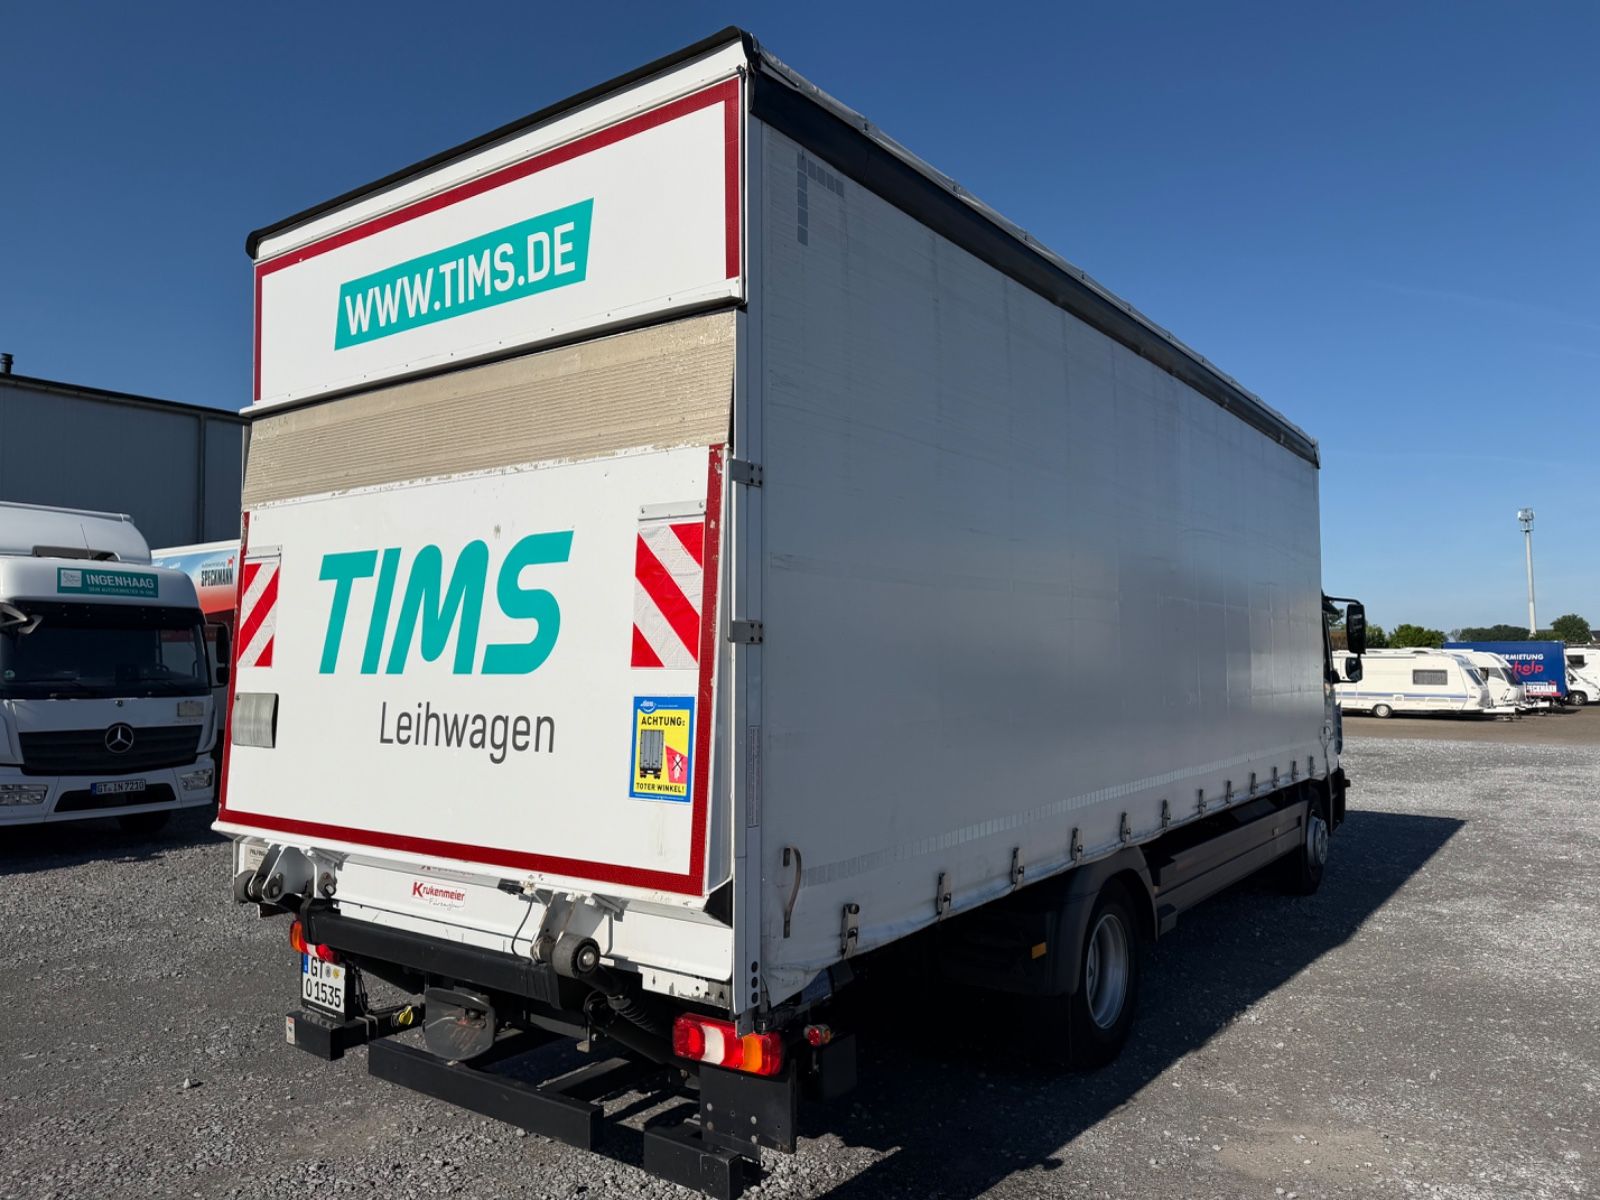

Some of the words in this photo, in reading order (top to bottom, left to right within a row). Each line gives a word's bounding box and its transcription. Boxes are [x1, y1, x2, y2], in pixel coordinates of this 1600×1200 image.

[344, 221, 576, 336] WWW.TIMS.DE
[86, 574, 155, 589] INGENHAAG
[318, 530, 575, 675] TIMS
[379, 701, 555, 764] Leihwagen
[636, 782, 656, 791] TOTER
[412, 881, 465, 902] Krukenmeier
[310, 956, 326, 979] GT
[314, 981, 342, 1009] 1535
